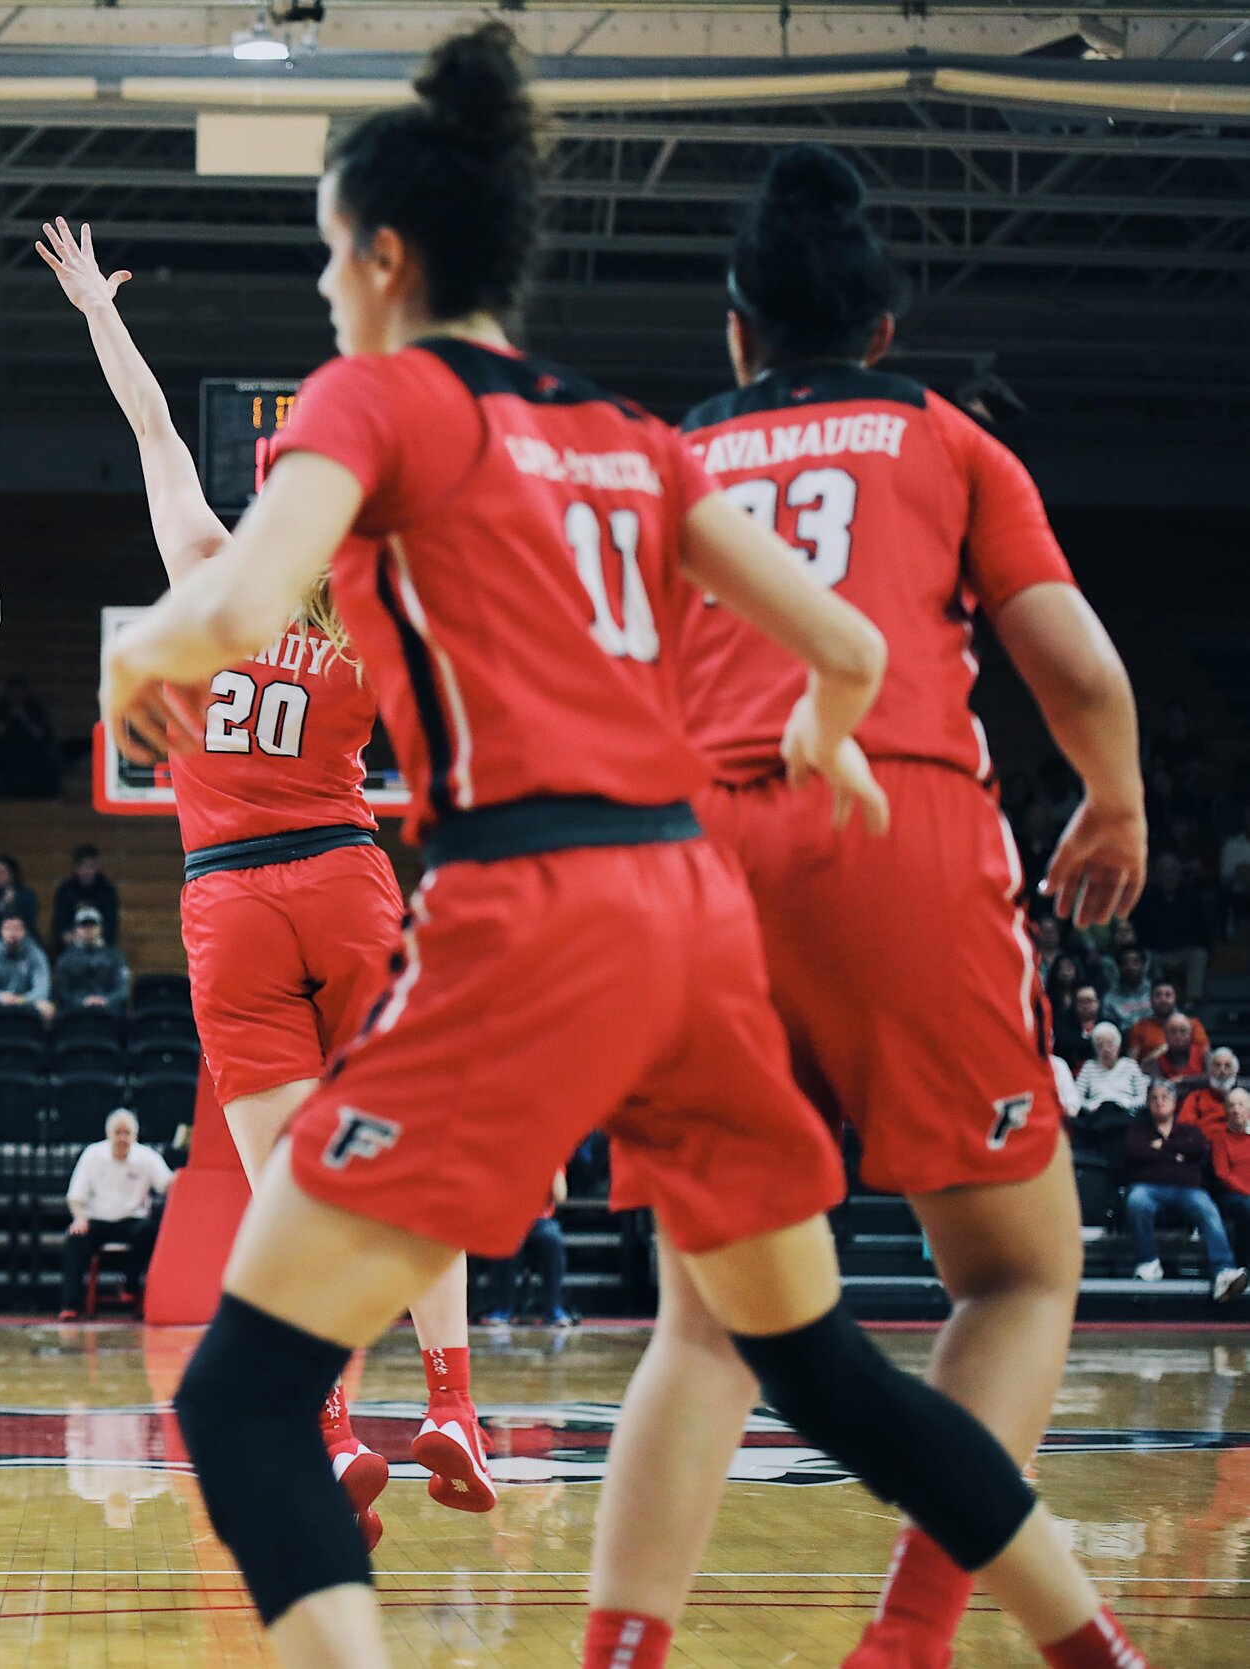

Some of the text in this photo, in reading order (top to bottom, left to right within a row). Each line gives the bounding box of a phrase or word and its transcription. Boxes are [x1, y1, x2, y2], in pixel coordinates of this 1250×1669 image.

[692, 412, 908, 476] AVANAUGH
[244, 632, 332, 675] NDY
[204, 669, 311, 758] 20
